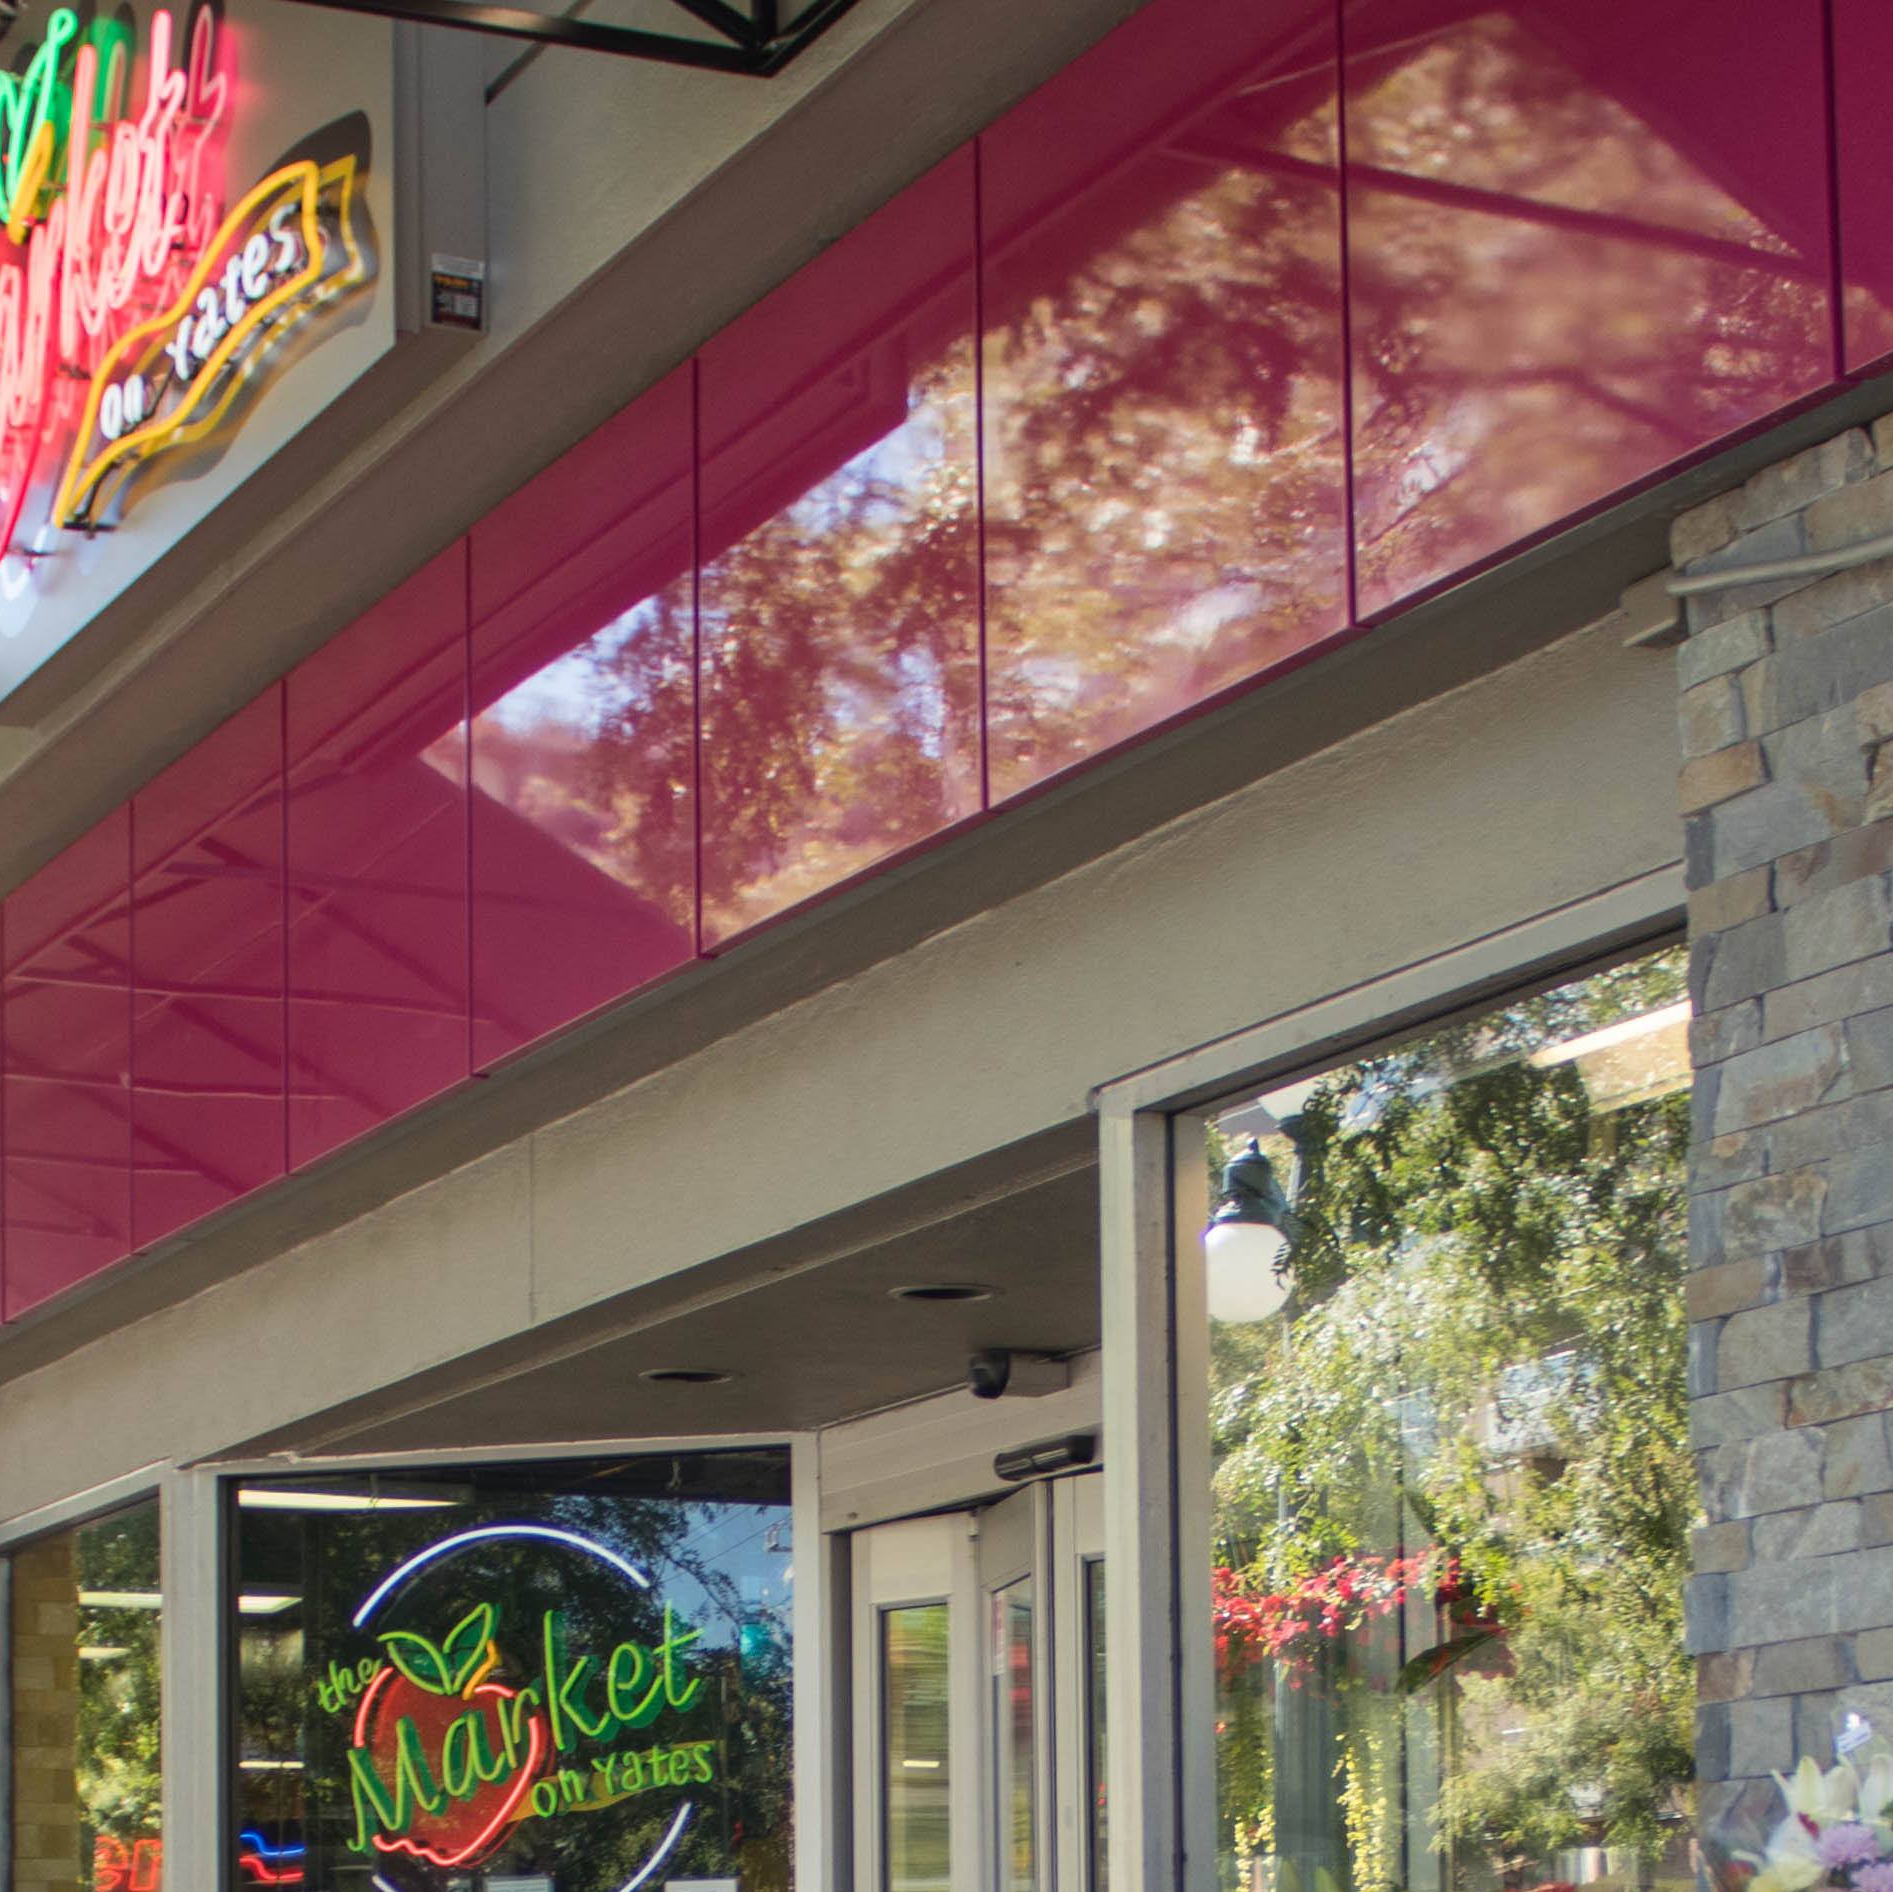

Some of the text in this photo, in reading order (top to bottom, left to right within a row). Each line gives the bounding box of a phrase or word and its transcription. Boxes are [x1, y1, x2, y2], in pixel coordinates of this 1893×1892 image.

[99, 374, 144, 441] on
[317, 1657, 383, 1713] the
[346, 1600, 704, 1854] Market
[531, 1743, 714, 1818] on Yates
